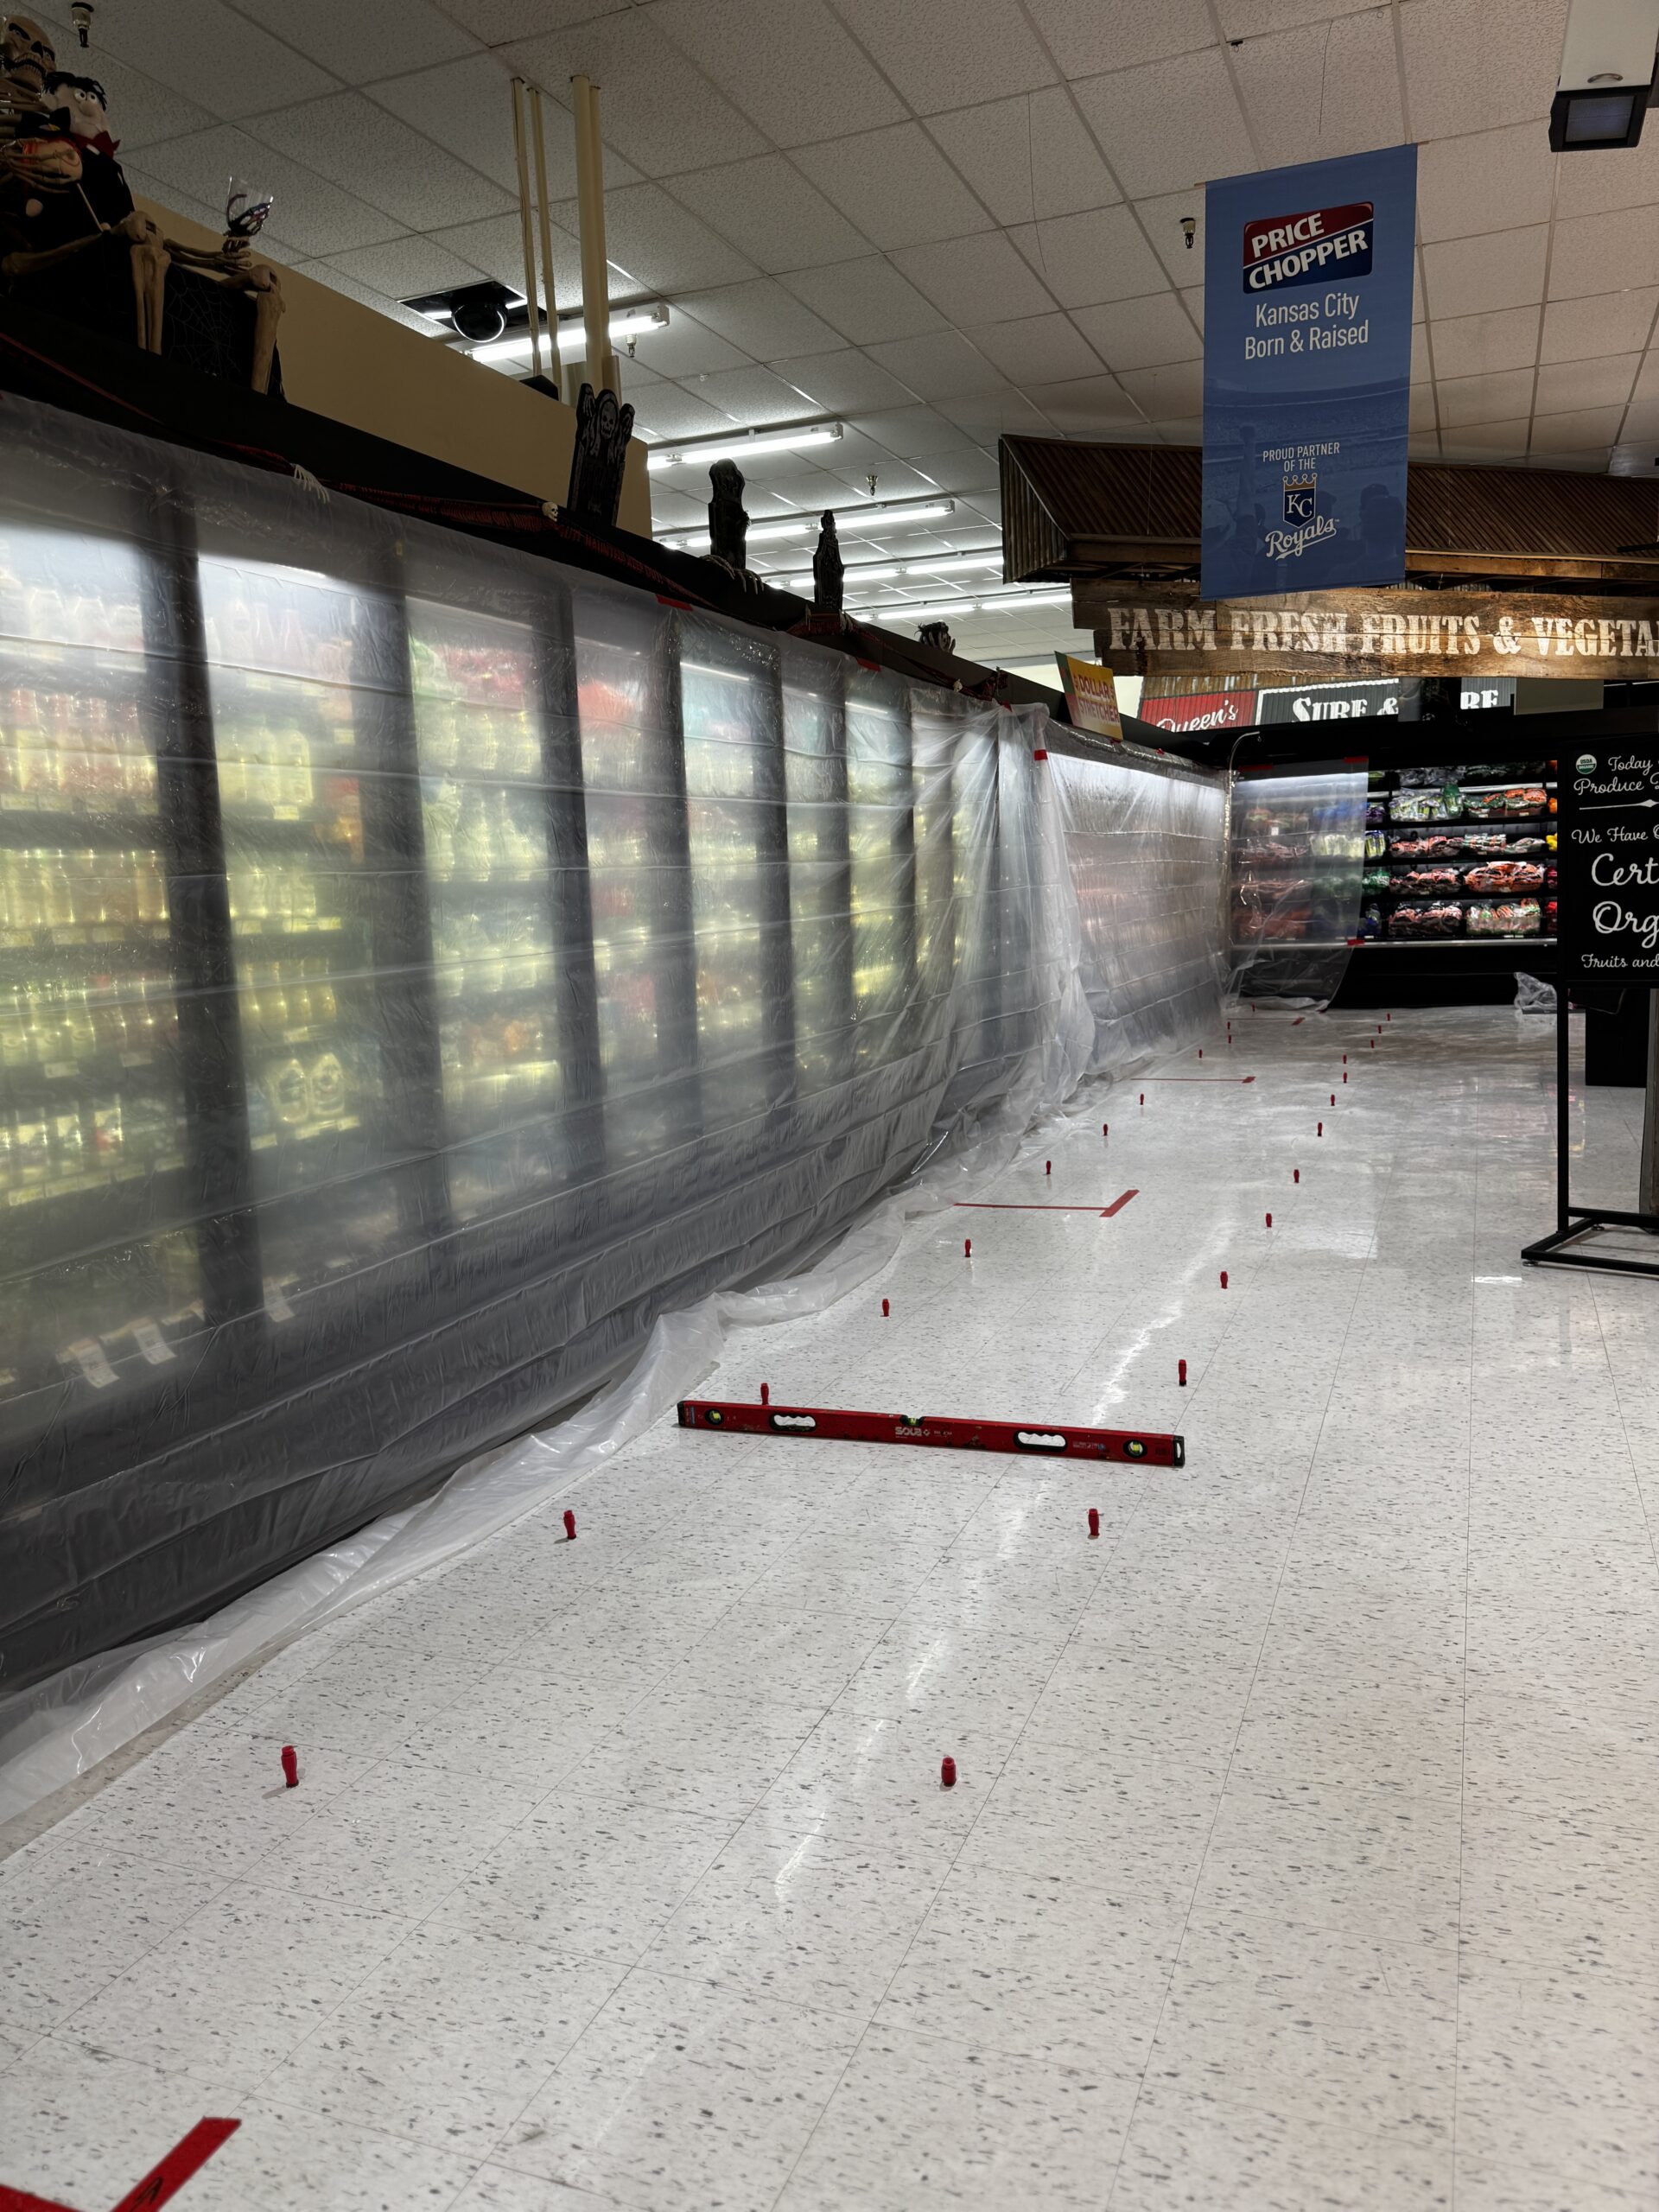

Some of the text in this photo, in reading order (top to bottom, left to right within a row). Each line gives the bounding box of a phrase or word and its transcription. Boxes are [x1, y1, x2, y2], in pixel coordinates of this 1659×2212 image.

[1251, 213, 1325, 258] PRICE
[1249, 230, 1369, 289] CHOPPER
[1255, 292, 1359, 328] Kansas City
[1245, 319, 1369, 359] Born & Raised
[1262, 442, 1340, 462] PROUD PARTNER
[1283, 457, 1316, 473] OF THE
[1286, 493, 1313, 518] KC
[1264, 515, 1337, 561] Royals
[1107, 607, 1659, 657] FARM FRESH FRUITS & VEGETA
[1078, 698, 1120, 723] STRETCHER
[1607, 754, 1654, 776] Today
[1573, 776, 1645, 796] Produce
[1571, 829, 1602, 844] We
[1606, 826, 1649, 843] Have
[1581, 953, 1629, 968] Fruits
